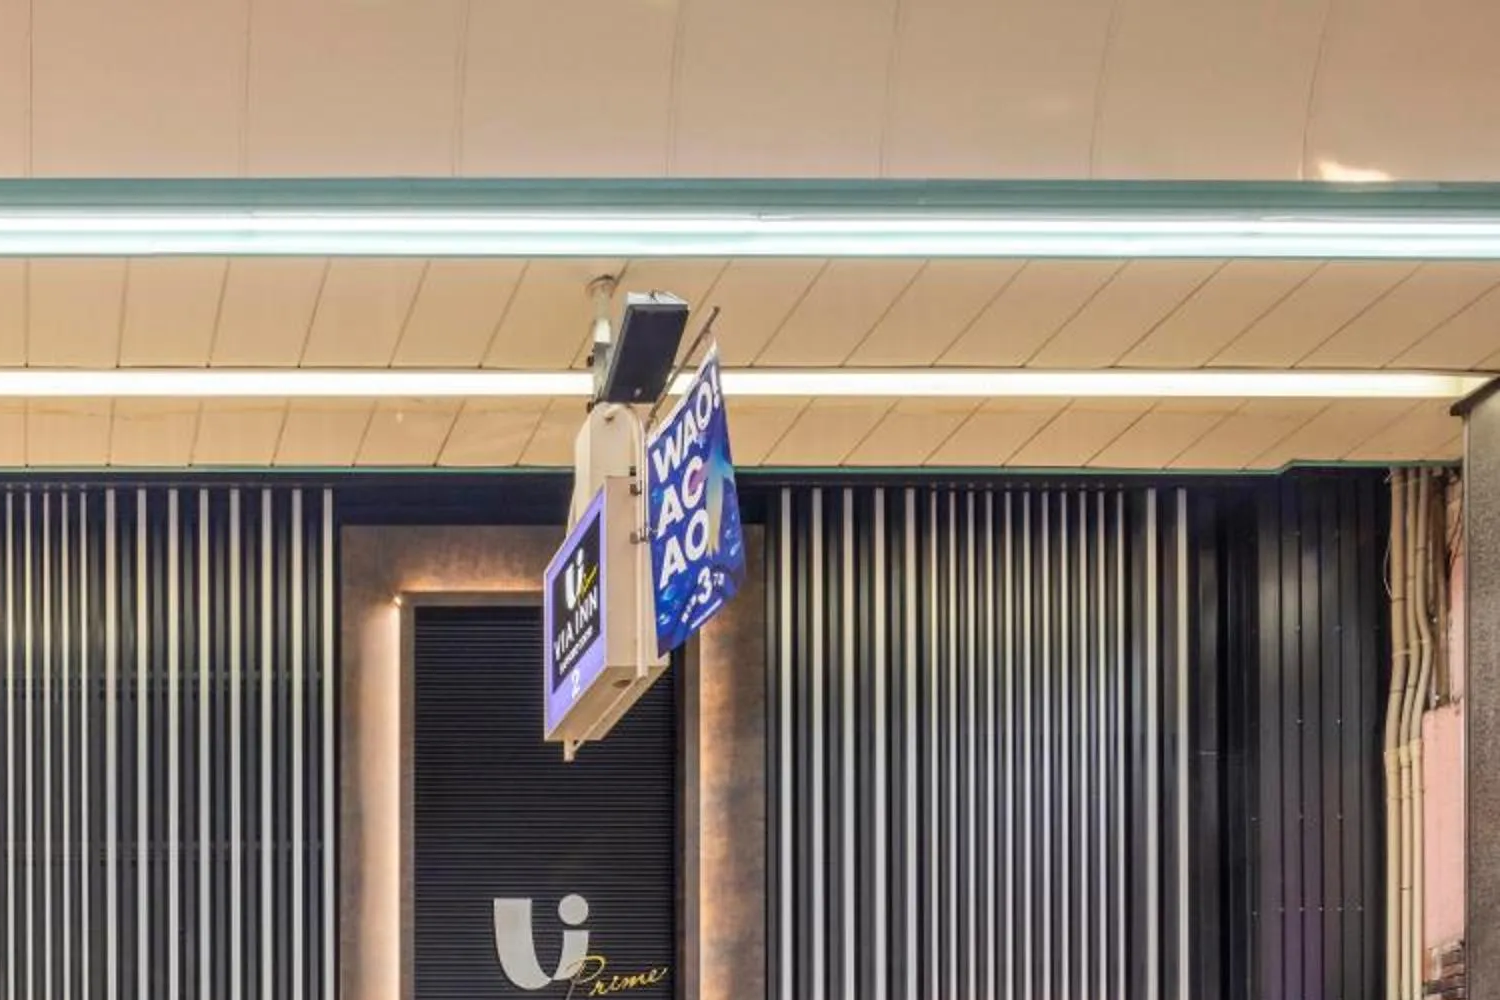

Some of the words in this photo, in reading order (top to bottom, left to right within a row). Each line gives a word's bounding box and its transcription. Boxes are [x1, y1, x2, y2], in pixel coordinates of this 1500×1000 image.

[652, 365, 719, 483] WAO!
[554, 621, 575, 661] VIA
[574, 586, 598, 635] INN
